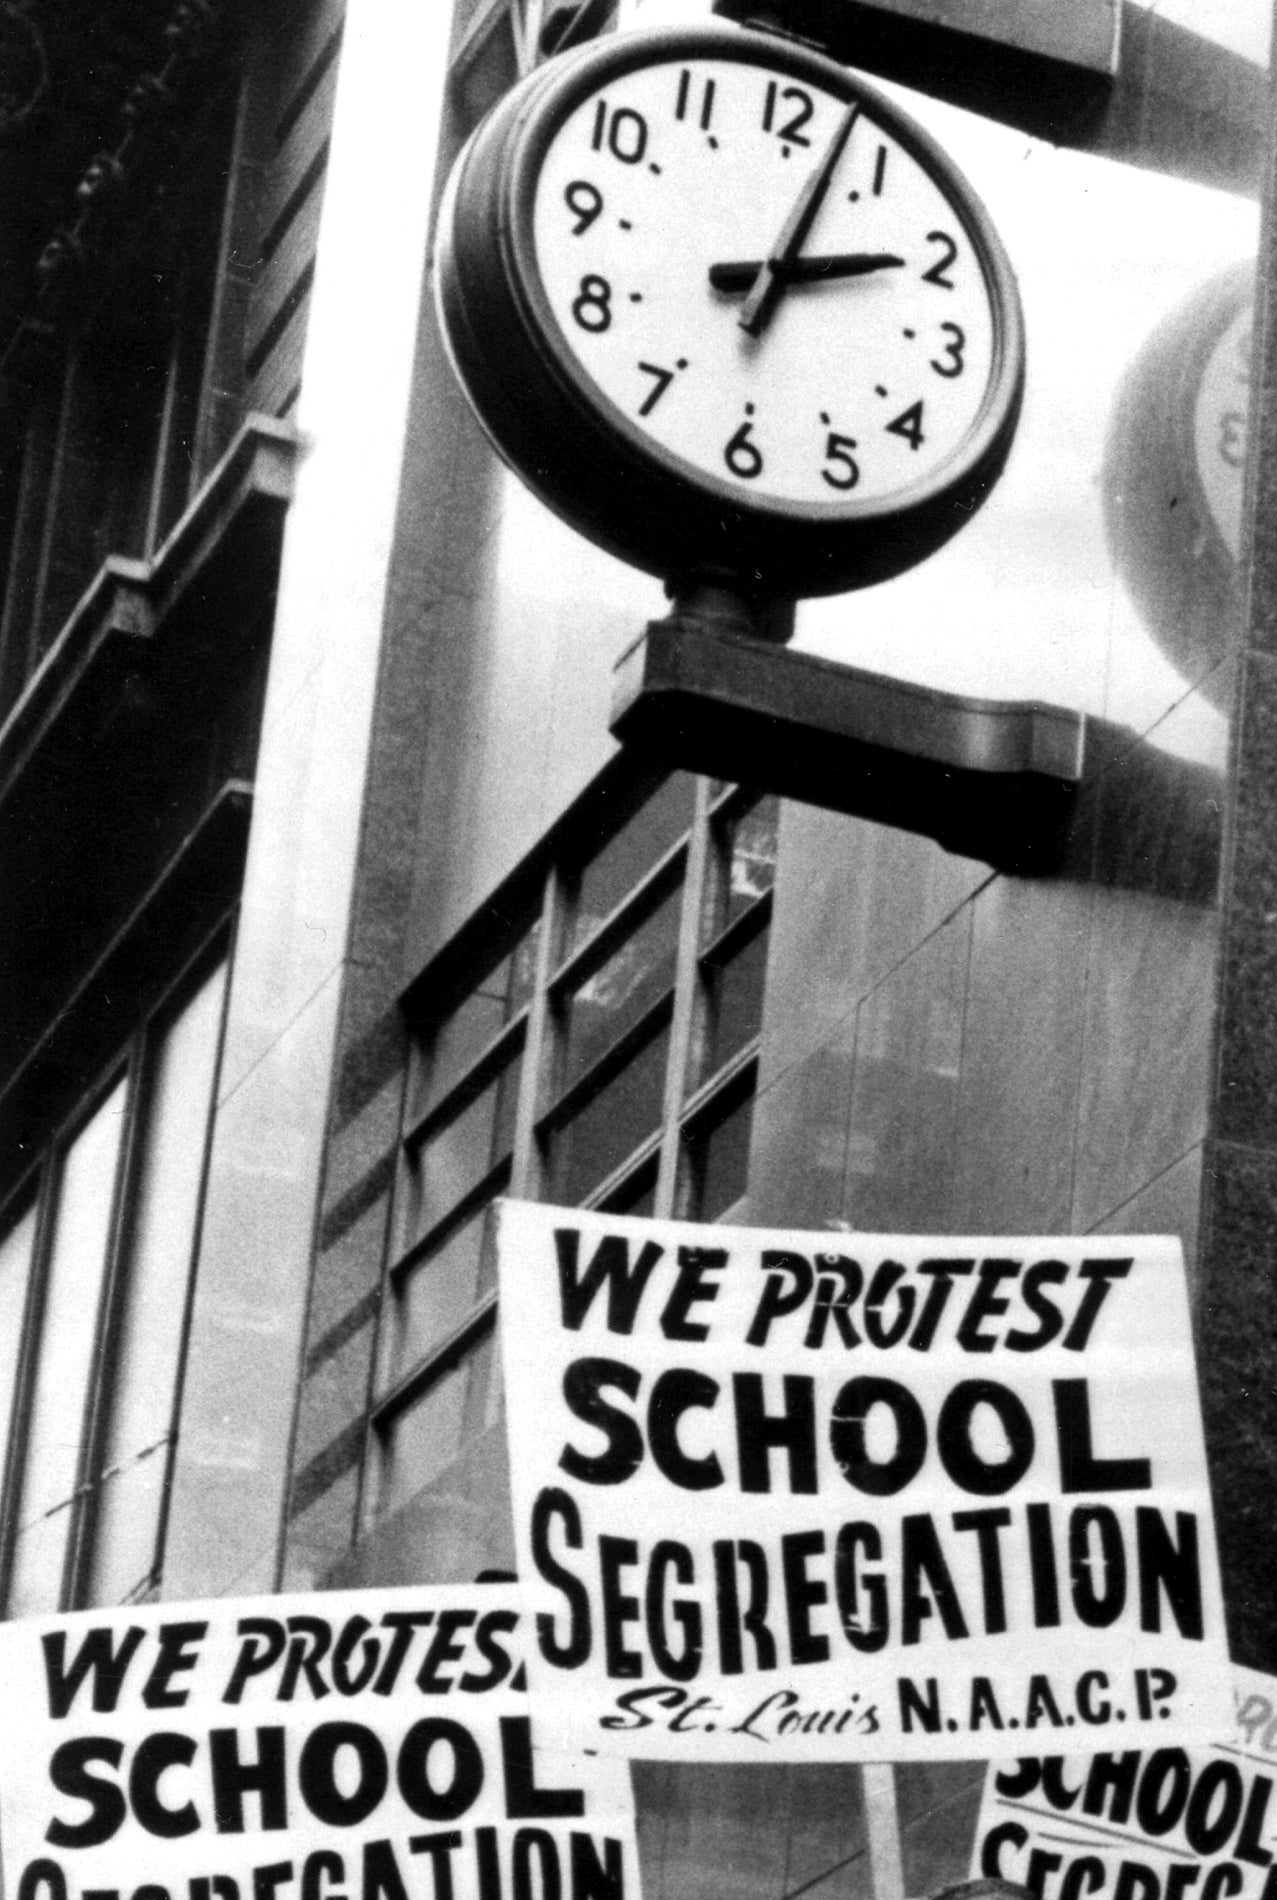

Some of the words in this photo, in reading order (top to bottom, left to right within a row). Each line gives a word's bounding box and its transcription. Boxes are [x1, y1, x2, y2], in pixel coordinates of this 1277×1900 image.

[674, 69, 715, 132] 11
[761, 79, 815, 148] 12
[591, 100, 648, 166] 10
[873, 143, 888, 197] 1
[563, 180, 604, 236] 9
[921, 231, 959, 289] 2
[572, 275, 612, 333] 8
[928, 321, 966, 378] 3
[637, 360, 675, 416] 7
[724, 421, 763, 479] 6
[884, 398, 926, 452] 4
[821, 432, 861, 490] 5
[553, 1228, 731, 1342] WE
[744, 1247, 1136, 1353] PROTEST
[557, 1356, 1153, 1498] SCHOOL
[530, 1486, 1205, 1684] SEGREGATION
[41, 1620, 210, 1720] WE
[222, 1609, 528, 1705] PROTES
[599, 1685, 717, 1735] St.
[731, 1690, 881, 1743] Louis
[897, 1667, 1178, 1736] N.A.A.C.P.
[44, 1715, 586, 1849] SCHOOL
